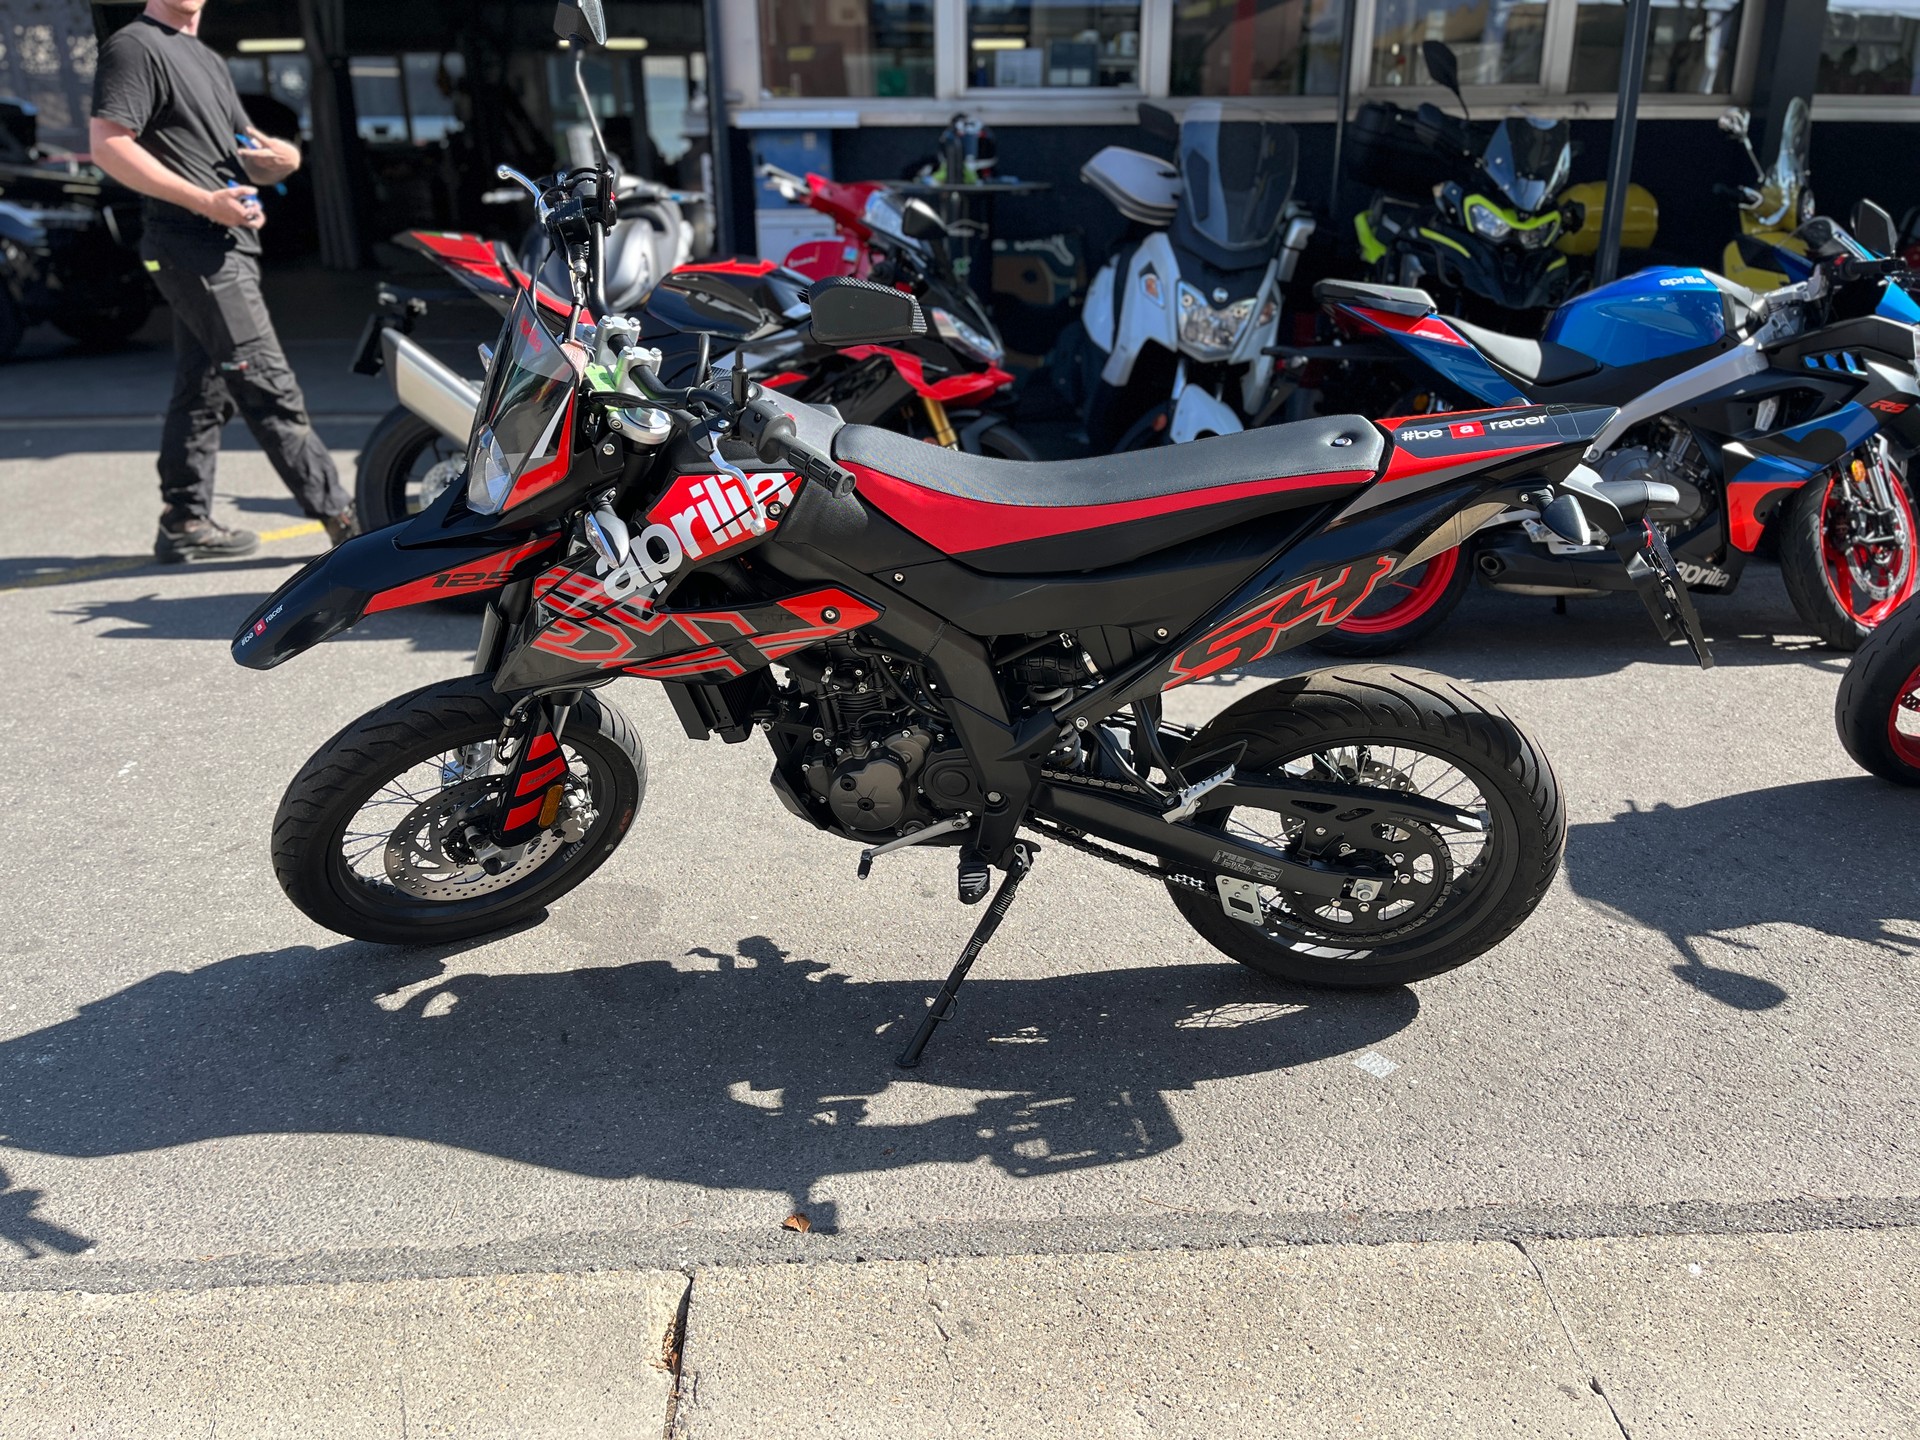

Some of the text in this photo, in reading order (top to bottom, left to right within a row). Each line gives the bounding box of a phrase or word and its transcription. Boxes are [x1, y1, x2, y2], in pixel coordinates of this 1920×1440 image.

[1659, 276, 1707, 286] aprilia
[1401, 429, 1443, 441] #be
[1489, 414, 1548, 430] racer
[265, 604, 283, 623] racer
